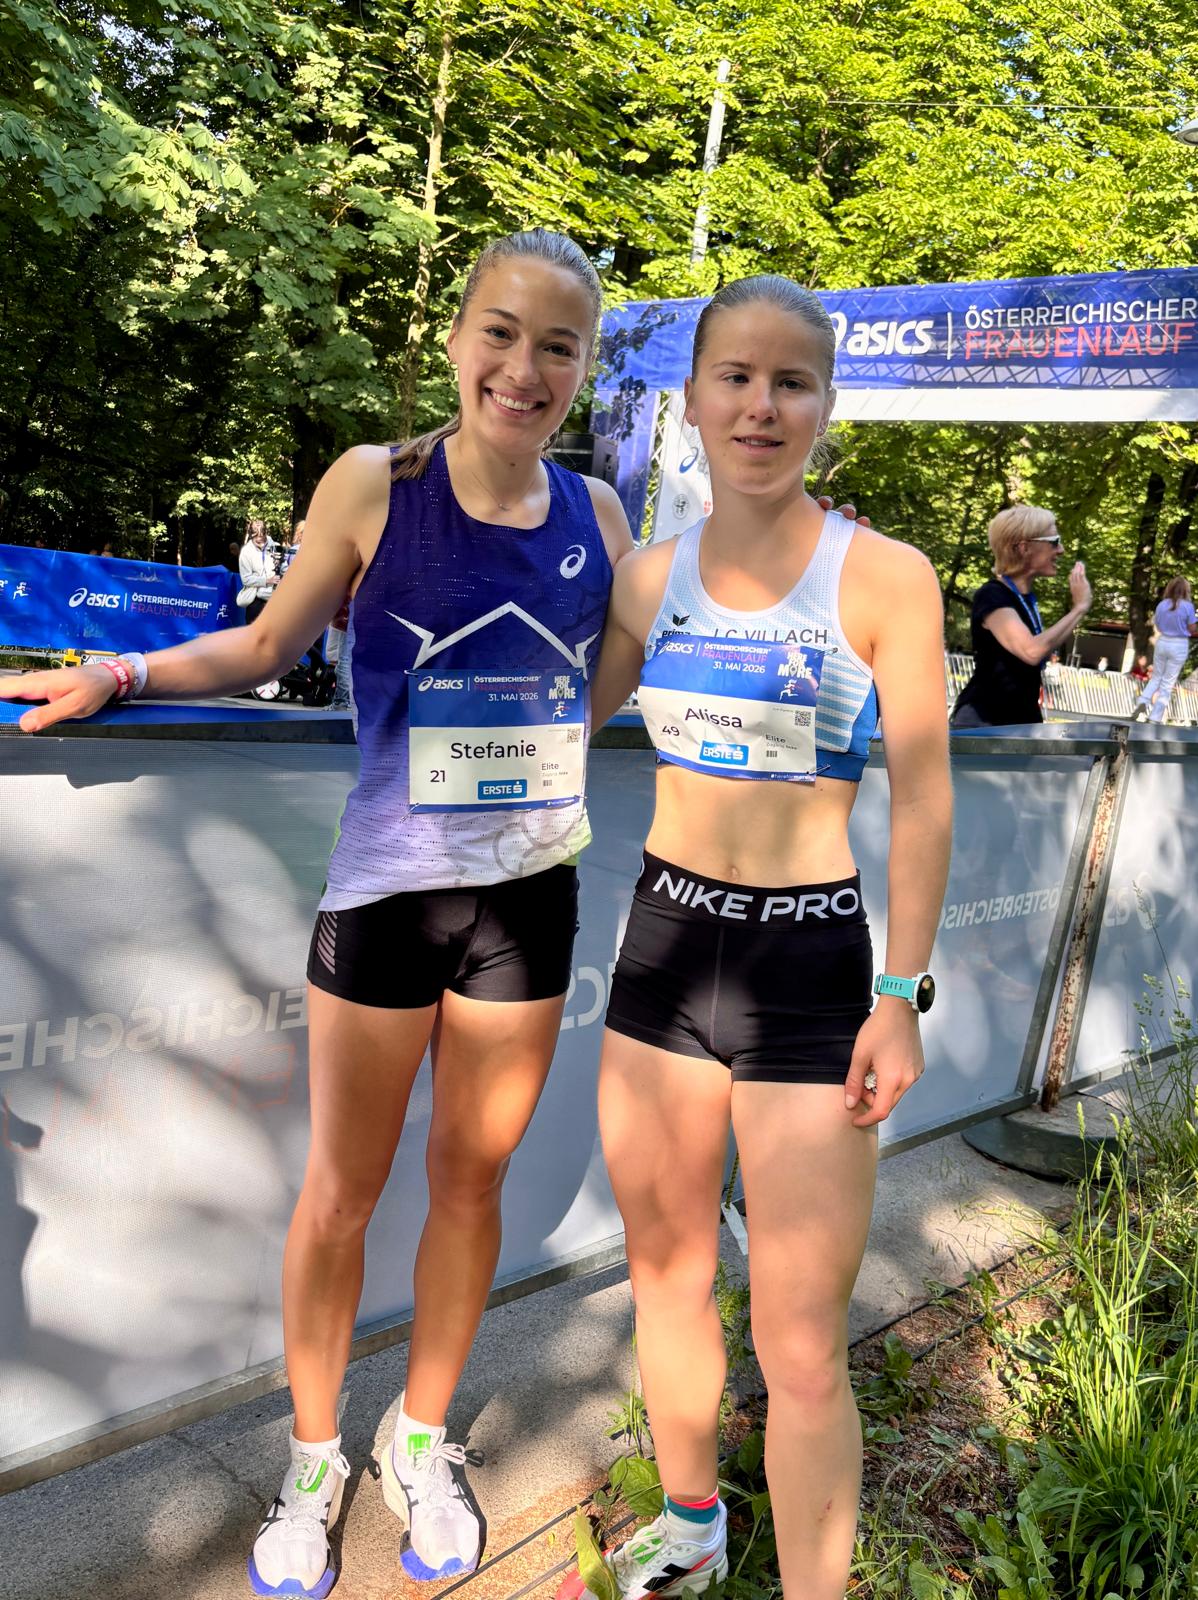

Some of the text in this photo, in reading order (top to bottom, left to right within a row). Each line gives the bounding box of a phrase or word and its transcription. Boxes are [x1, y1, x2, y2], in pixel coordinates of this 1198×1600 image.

[964, 298, 1198, 330] ÖSTERREICHISCHER
[964, 322, 1197, 360] FRAUENLAUF
[130, 602, 208, 619] FRAUENLAUF
[744, 629, 827, 644] VILLACH
[702, 652, 768, 663] FRAUENLAUF
[713, 661, 766, 674] 31. MAI 2026
[488, 692, 539, 702] 31. MAI 2026
[684, 708, 743, 729] Alissa
[662, 725, 680, 737] 49
[765, 734, 786, 743] Elite
[450, 740, 537, 760] Stefanie
[703, 746, 732, 759] ERSTE
[541, 763, 560, 771] Elite
[430, 770, 446, 783] 21
[483, 785, 512, 795] ERSTE
[652, 870, 860, 922] NIKE PRO
